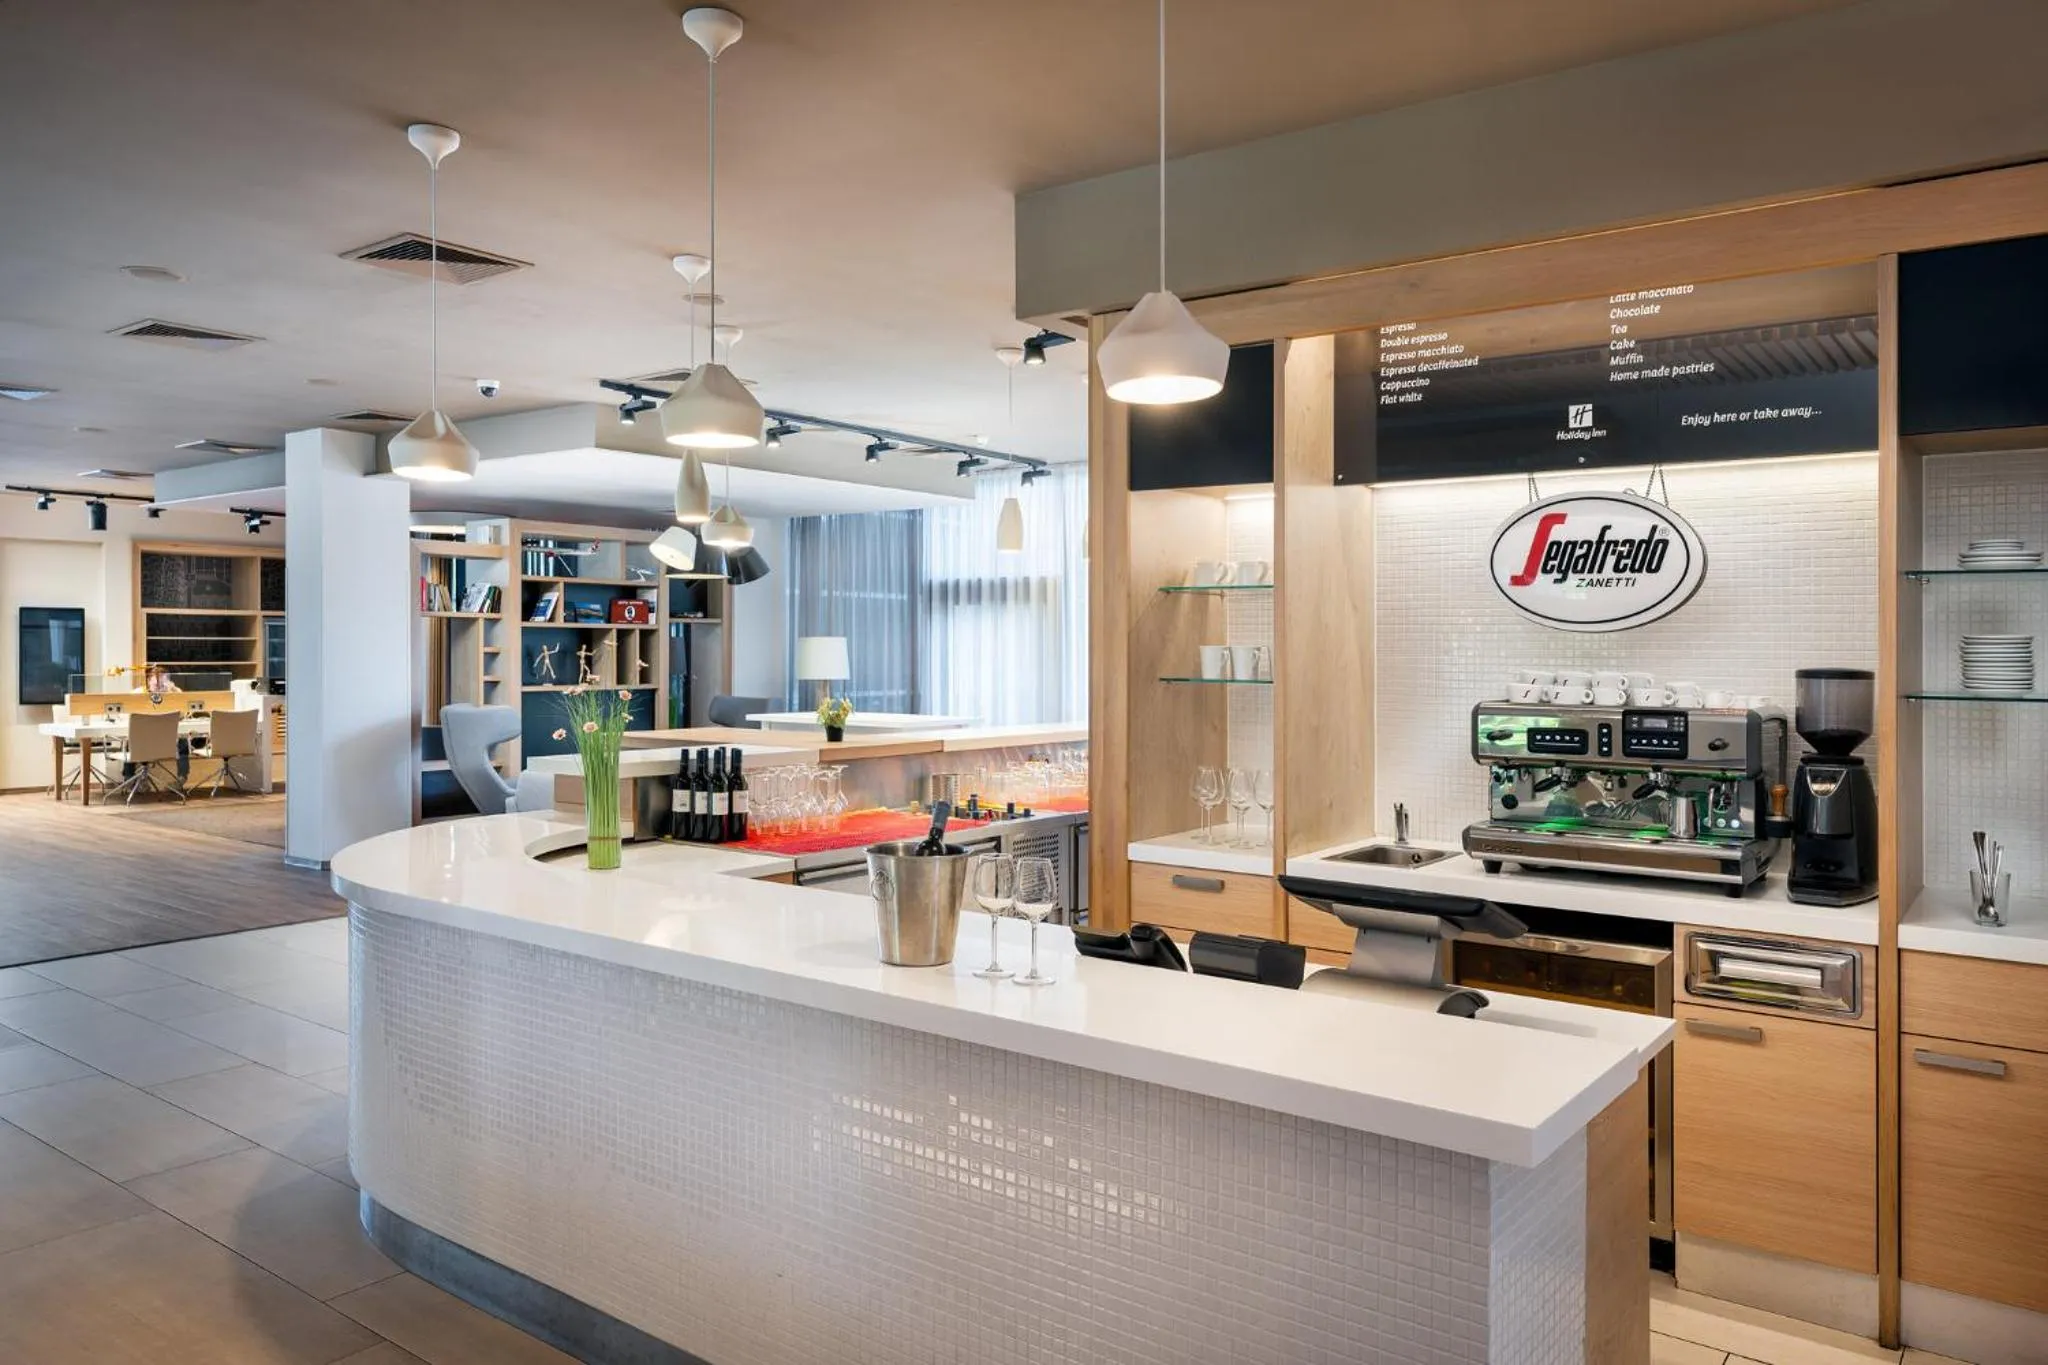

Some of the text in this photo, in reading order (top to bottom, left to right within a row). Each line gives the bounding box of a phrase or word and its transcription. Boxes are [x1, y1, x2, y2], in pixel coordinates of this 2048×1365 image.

[1609, 304, 1661, 318] Chocolate
[1610, 323, 1628, 334] Tea
[1380, 332, 1448, 347] Double espresso
[1609, 338, 1635, 349] Cake
[1380, 344, 1464, 362] Espresso macchiato
[1609, 353, 1643, 365] Muffin
[1380, 355, 1478, 377] Espresso decaffeinated
[1609, 361, 1715, 381] Home made pastries
[1380, 377, 1430, 391] Cappuccino
[1380, 391, 1423, 404] Flat white
[1681, 405, 1822, 426] Enjoy here or take away...
[1556, 427, 1607, 440] Holiday Inn
[1576, 577, 1637, 588] ZANETTI
